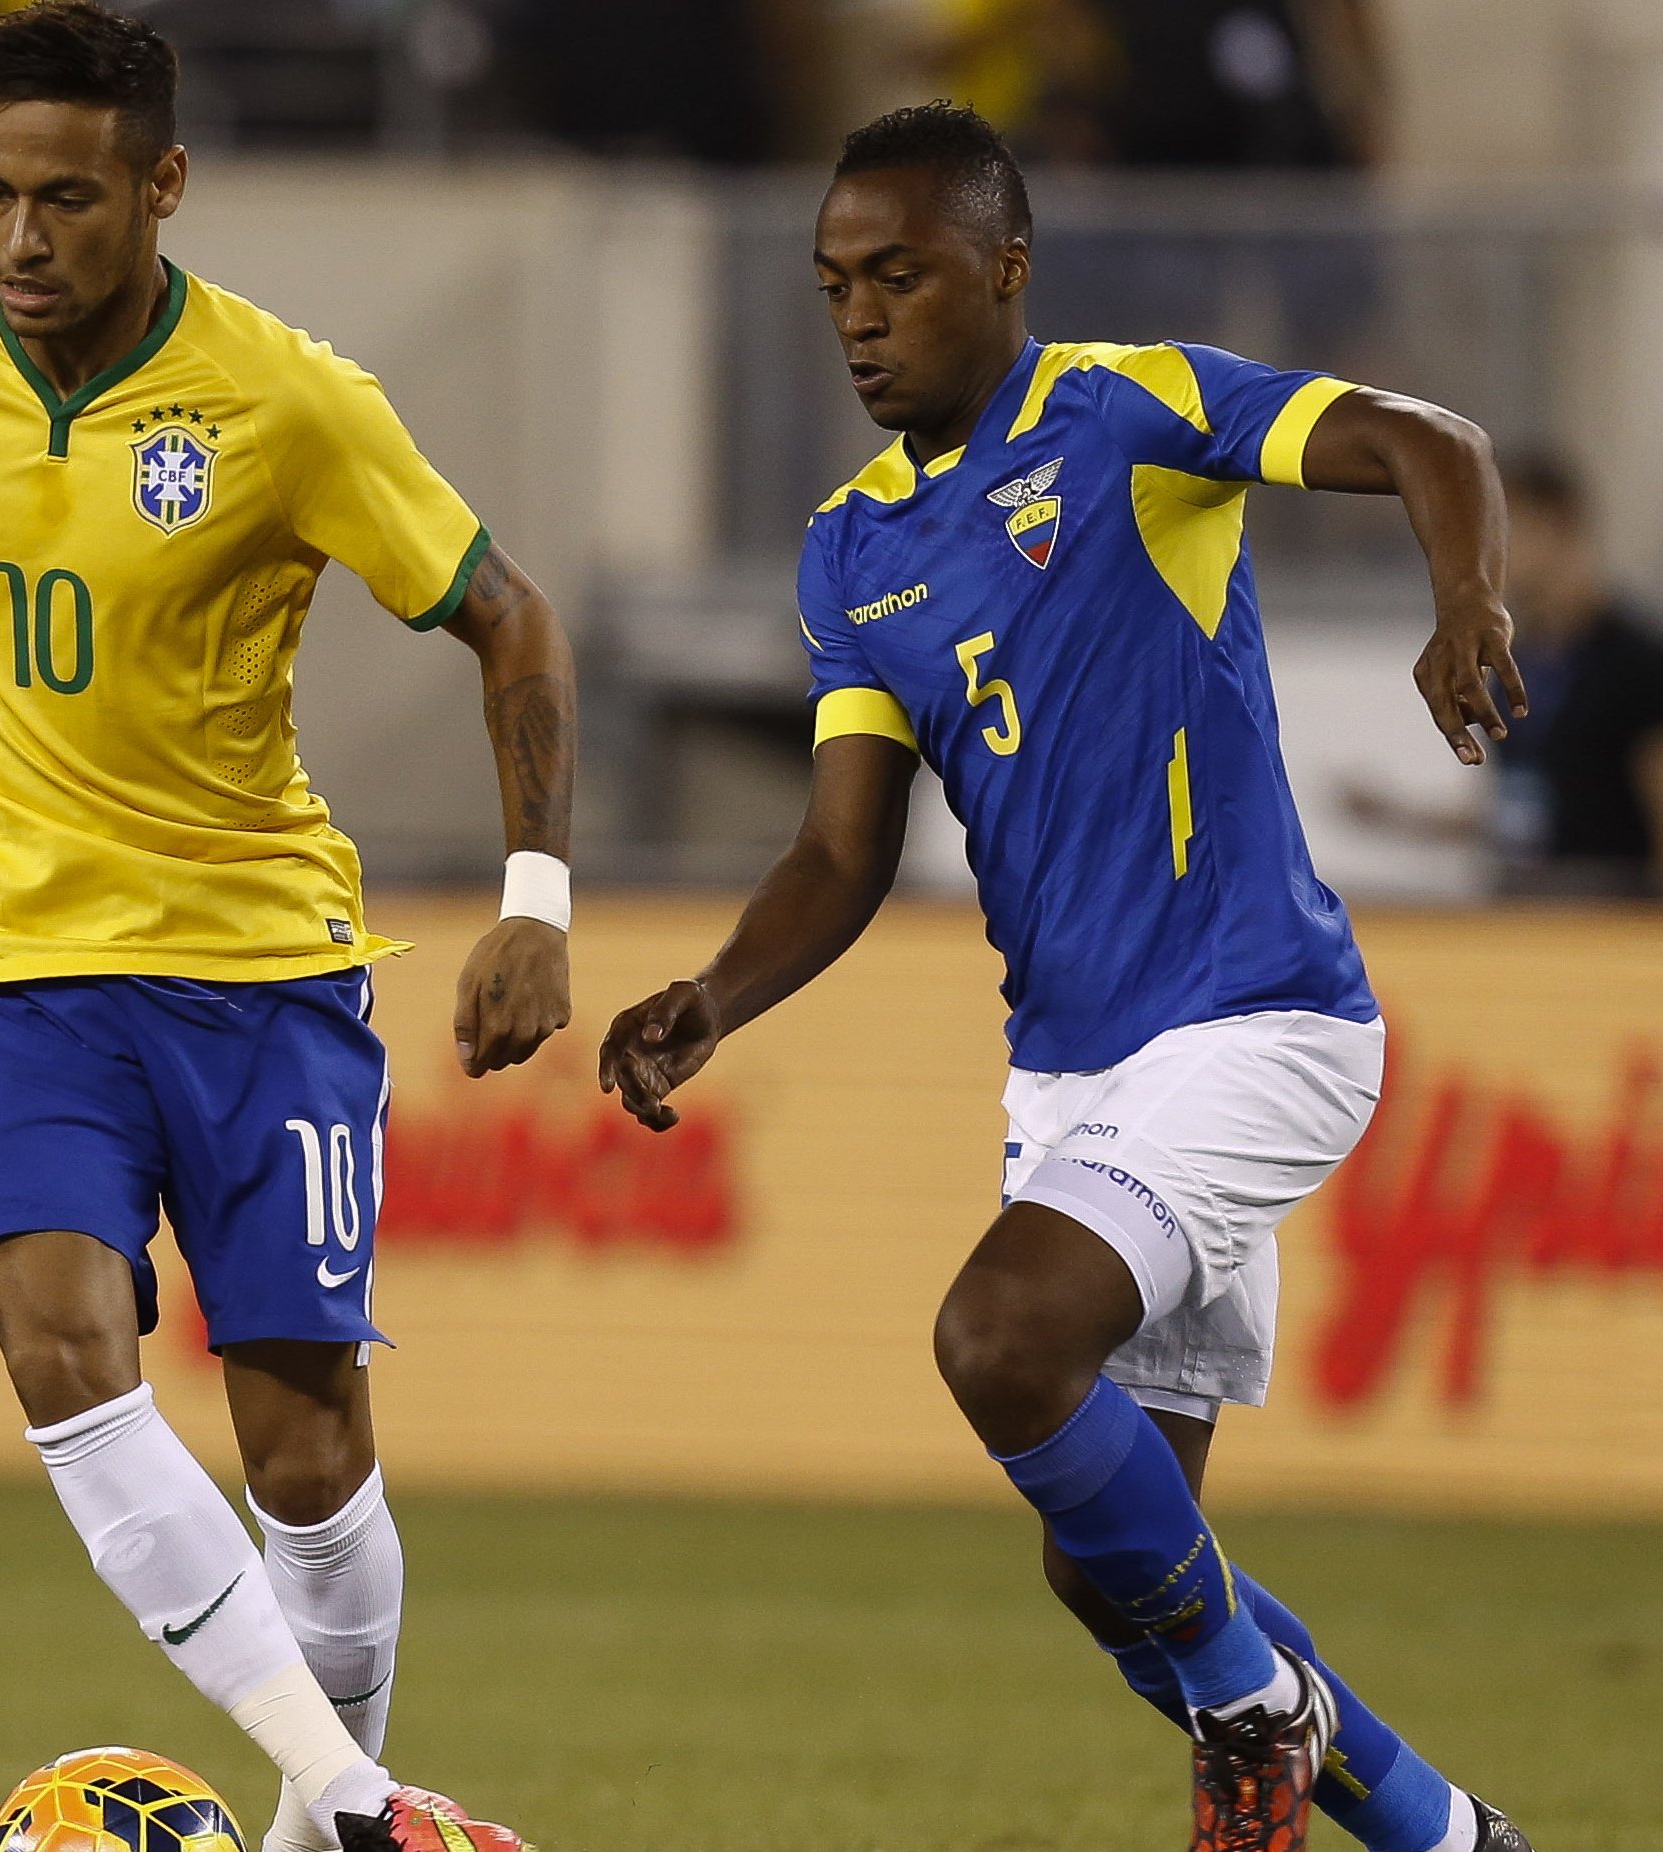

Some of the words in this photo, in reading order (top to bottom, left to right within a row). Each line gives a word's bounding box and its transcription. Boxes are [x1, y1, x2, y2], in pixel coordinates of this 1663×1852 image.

[157, 468, 186, 483] CBF
[1015, 507, 1049, 530] F.E.F.
[956, 632, 1022, 757] 5
[283, 1117, 362, 1254] 10
[1053, 1156, 1177, 1239] arathon
